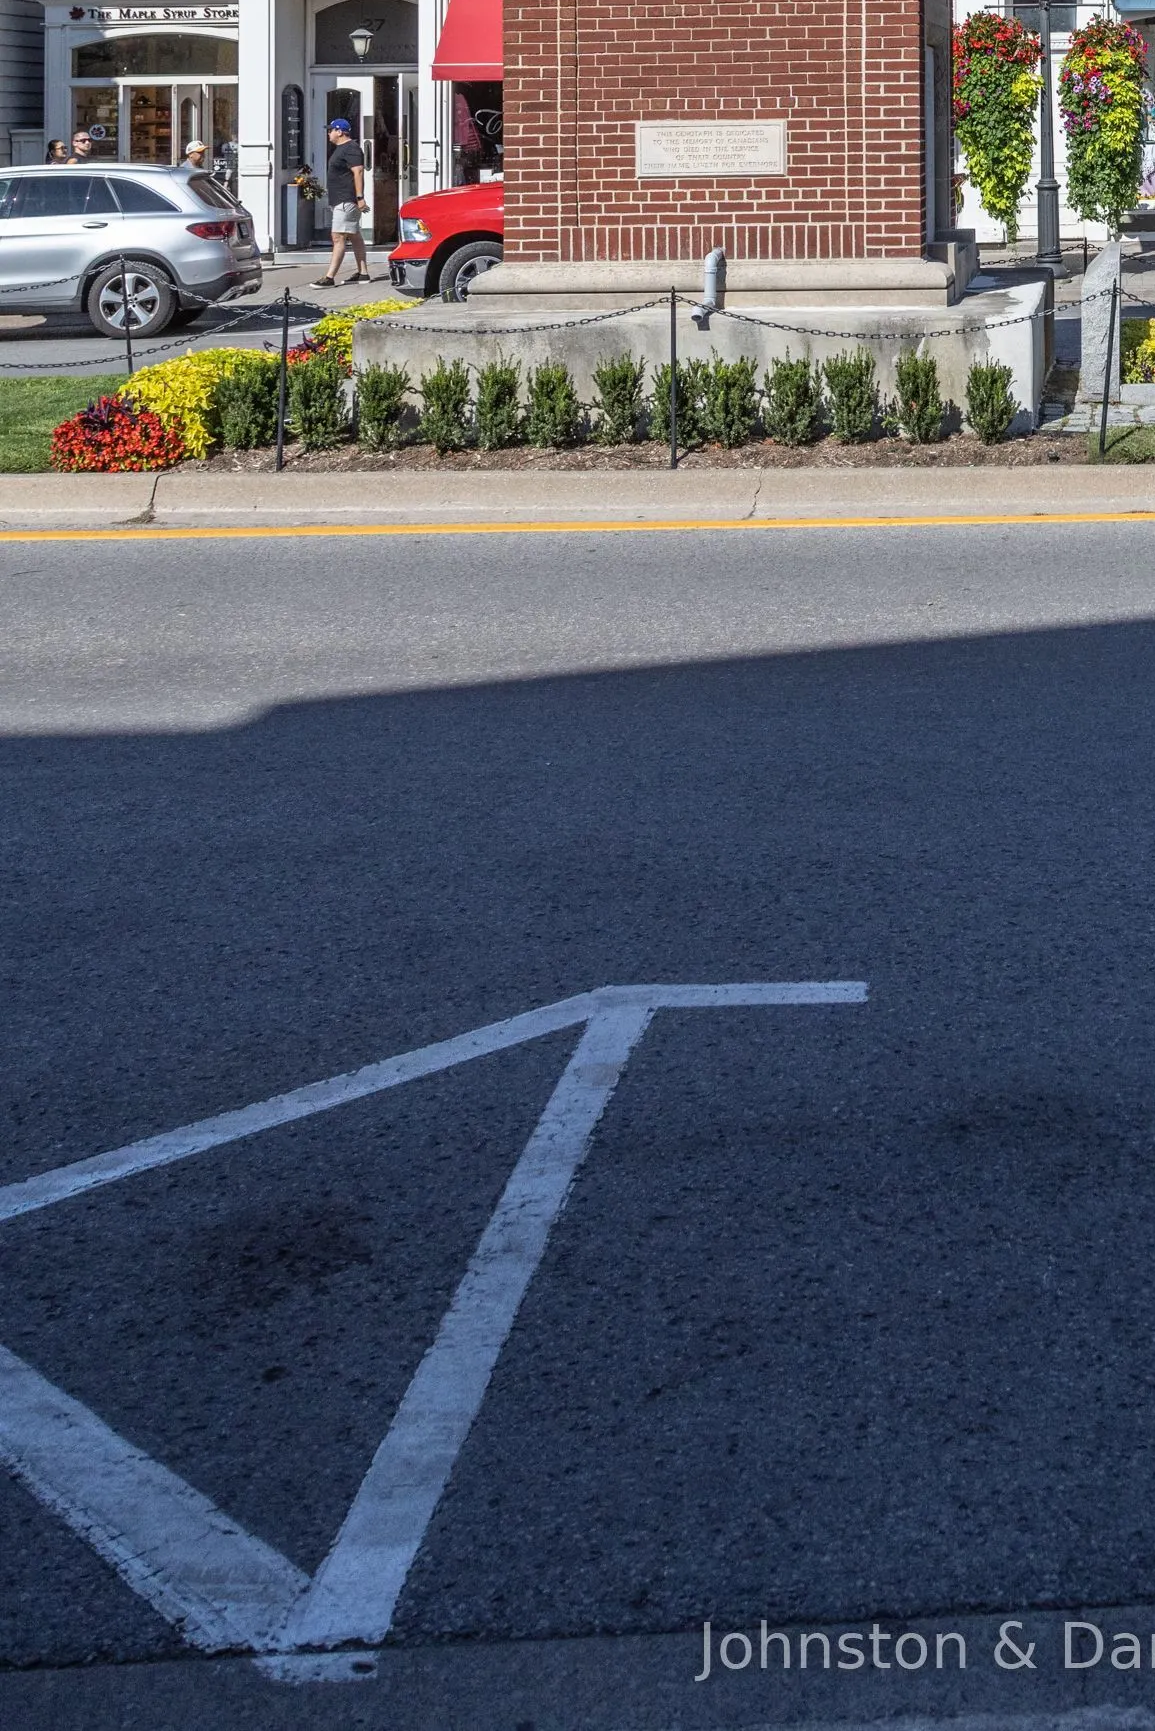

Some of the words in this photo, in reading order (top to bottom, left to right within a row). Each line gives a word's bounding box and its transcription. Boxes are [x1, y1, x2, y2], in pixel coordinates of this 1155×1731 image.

[88, 9, 112, 19] THE
[119, 8, 157, 19] MAPLE
[163, 8, 198, 19] SYRUP
[203, 7, 239, 18] STORE
